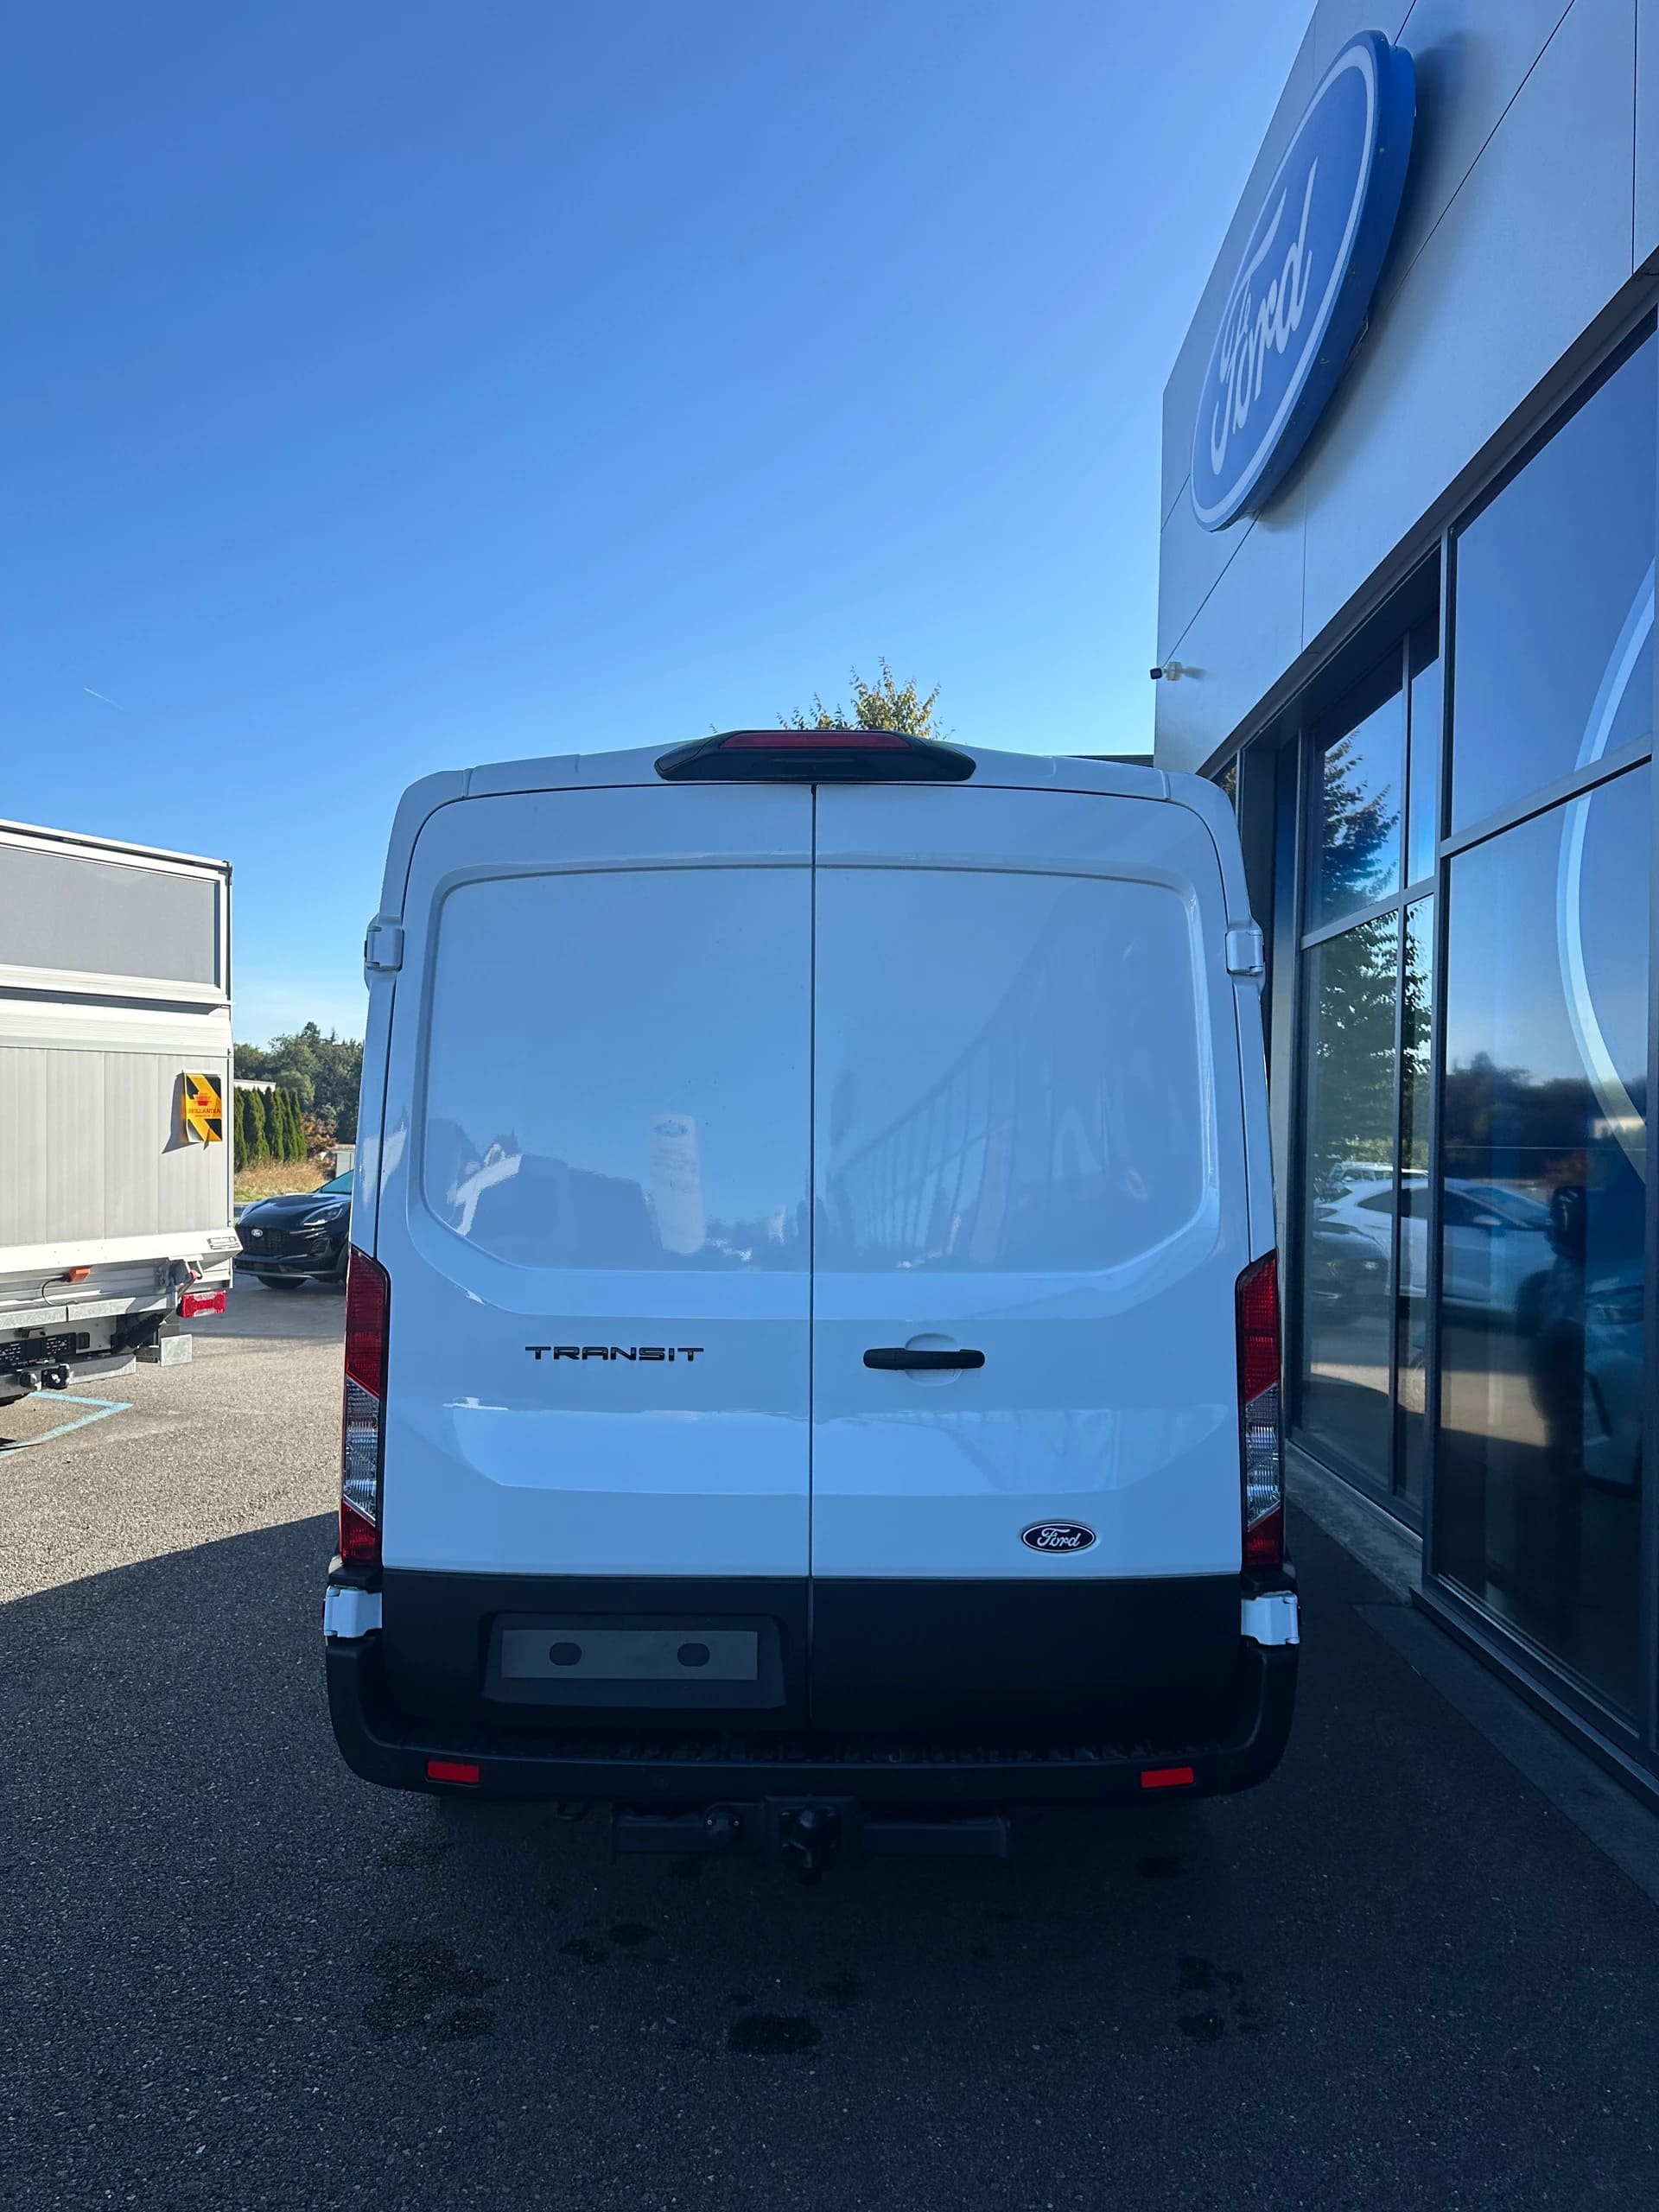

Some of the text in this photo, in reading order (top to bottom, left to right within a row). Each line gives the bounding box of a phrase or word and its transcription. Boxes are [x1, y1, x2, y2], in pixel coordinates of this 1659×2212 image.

[1211, 156, 1319, 475] Ford
[524, 1346, 704, 1362] TRANSIT
[1037, 1528, 1081, 1547] Ford
